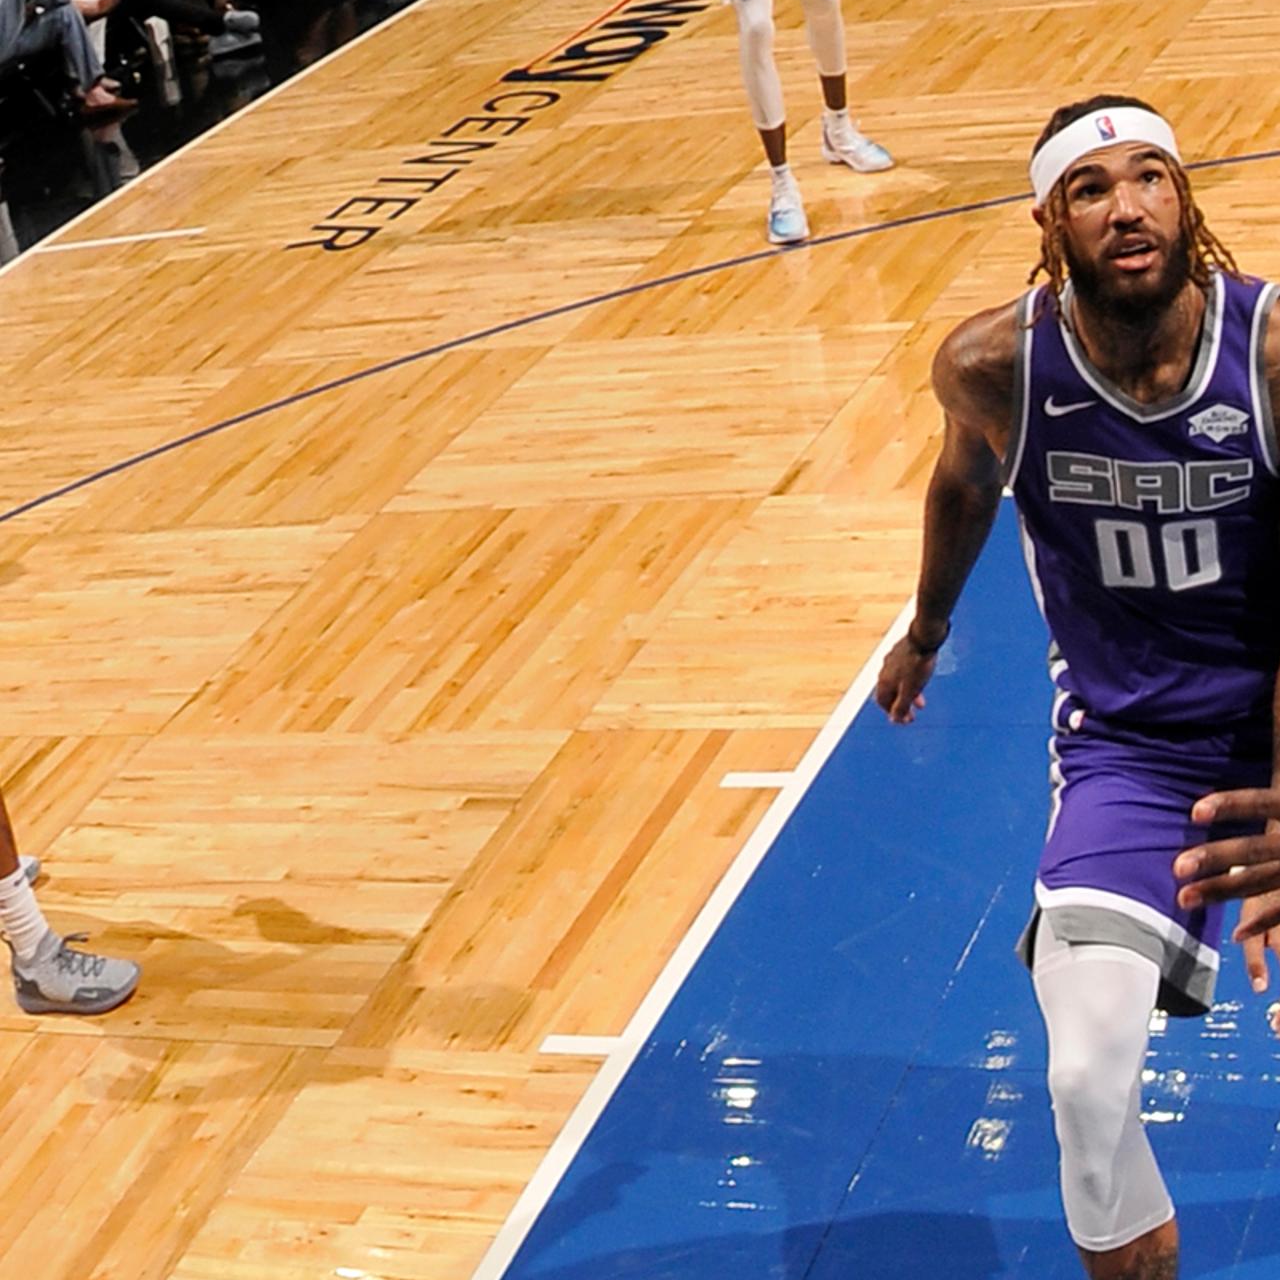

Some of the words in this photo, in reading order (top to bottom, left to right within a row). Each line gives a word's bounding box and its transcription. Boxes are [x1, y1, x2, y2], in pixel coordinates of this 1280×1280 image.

[283, 89, 561, 251] CENTER
[1047, 451, 1253, 515] SAC
[1095, 519, 1222, 592] 00
